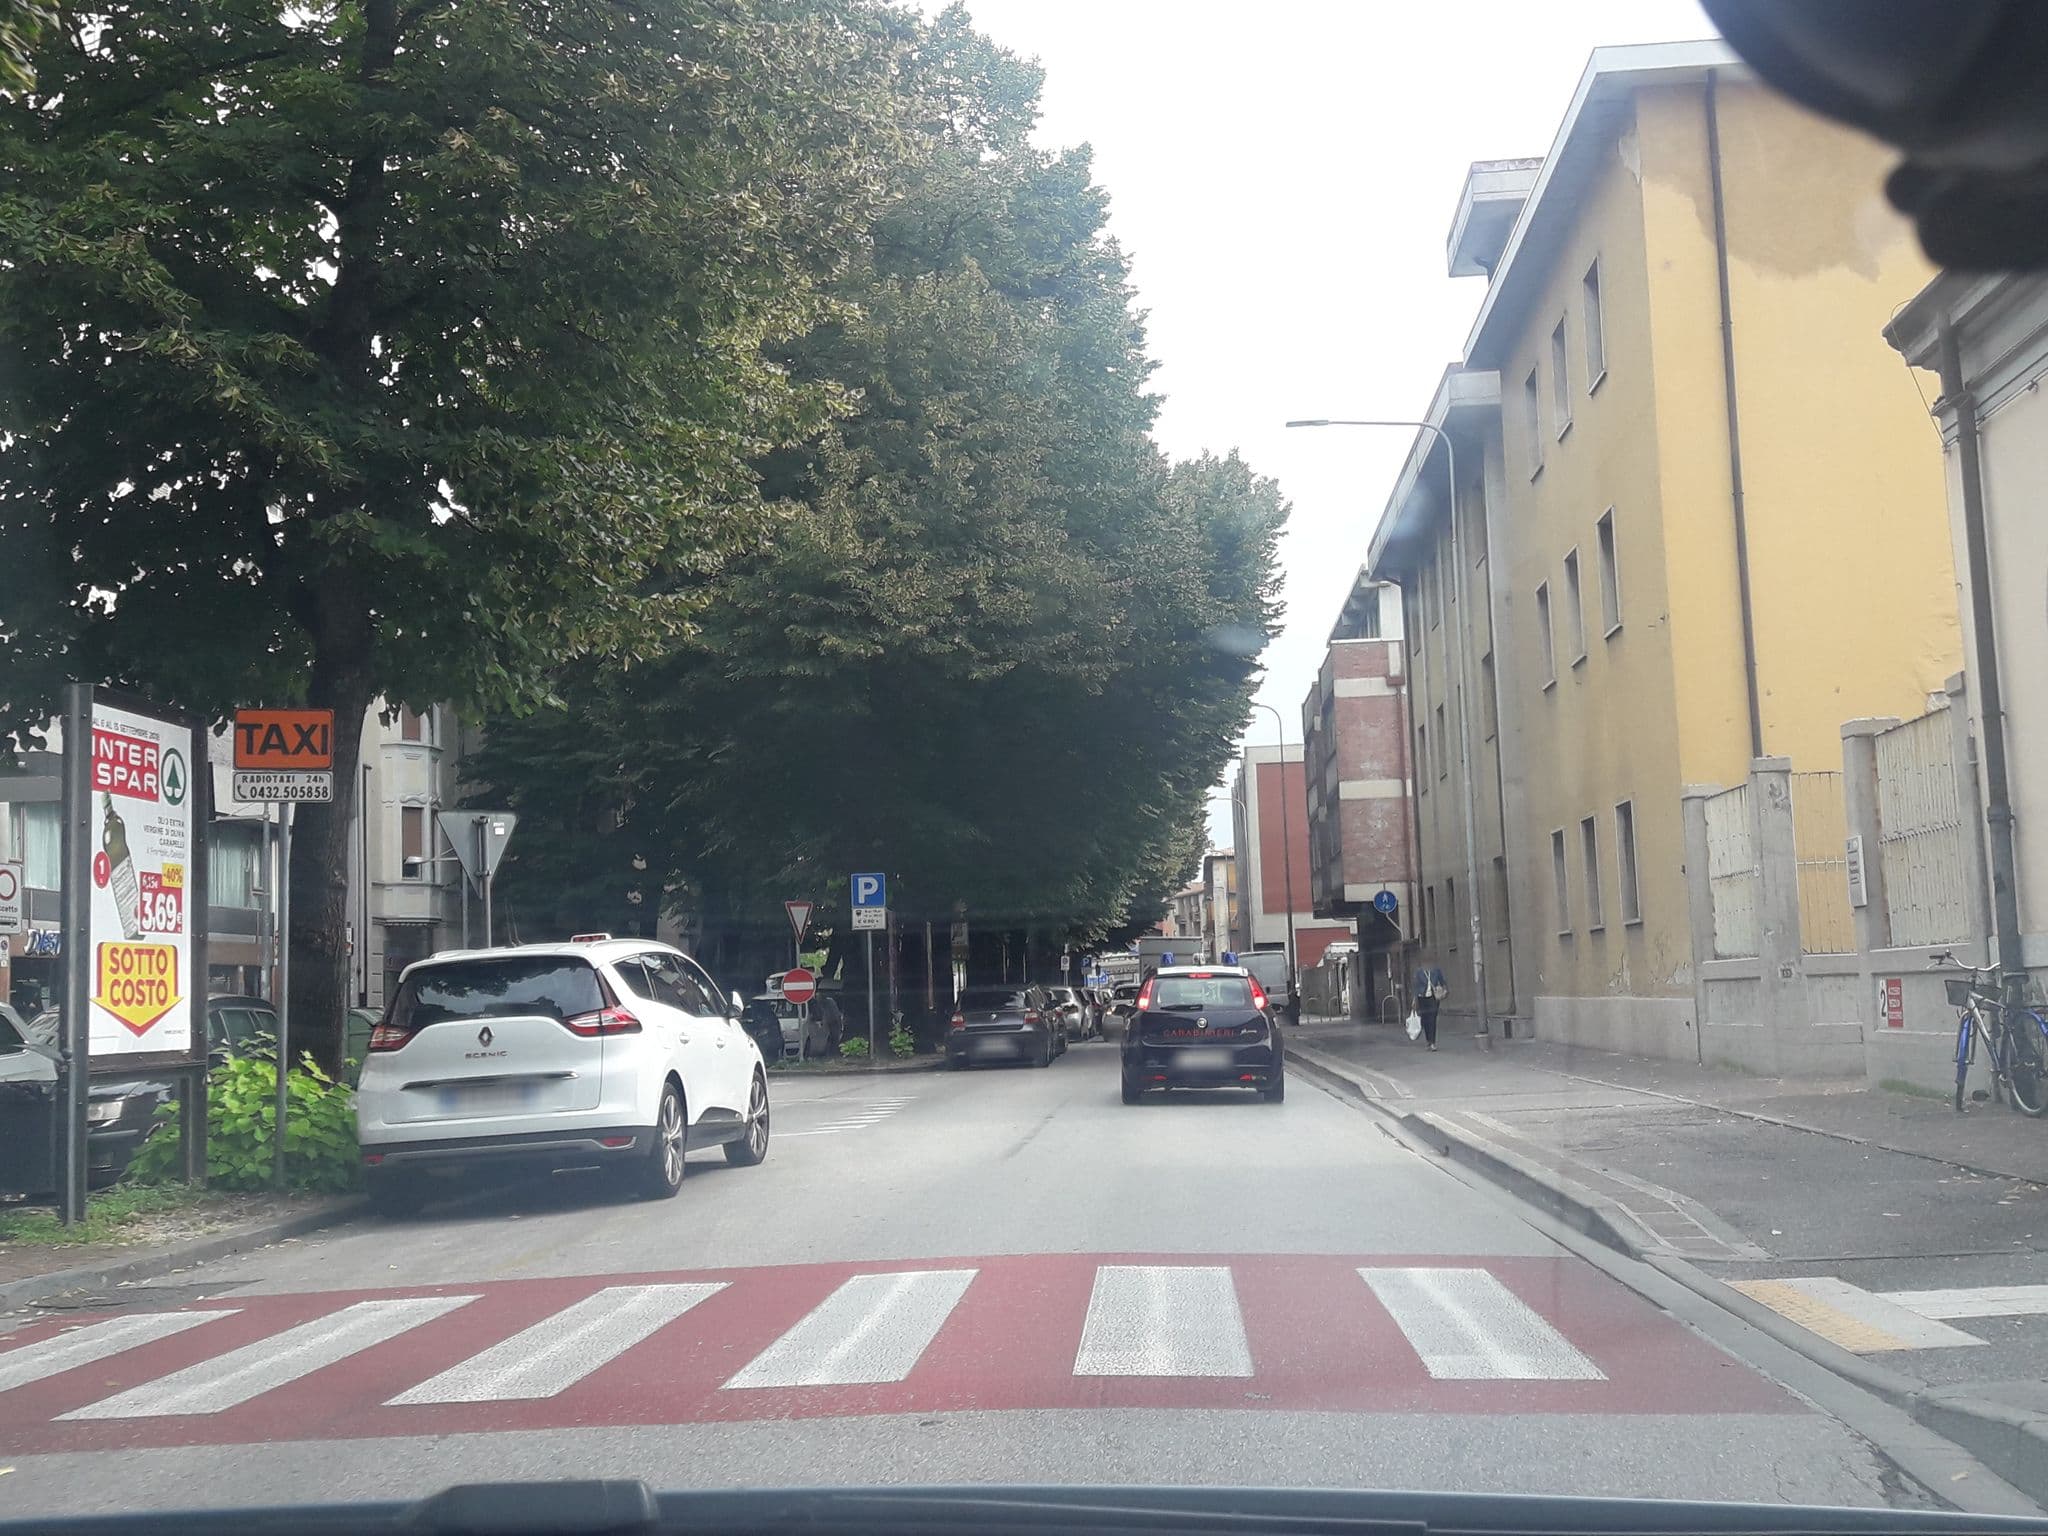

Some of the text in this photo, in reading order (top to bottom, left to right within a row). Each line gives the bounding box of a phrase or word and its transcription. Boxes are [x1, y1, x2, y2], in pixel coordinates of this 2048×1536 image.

[92, 735, 158, 770] INTER
[236, 723, 329, 755] TAXI
[96, 762, 158, 795] SPAR
[241, 774, 324, 784] RADIOTAXI 24h
[249, 786, 329, 799] 0432.505858
[858, 876, 879, 904] P
[109, 946, 168, 975] SOTTO
[110, 978, 168, 1007] COSTO
